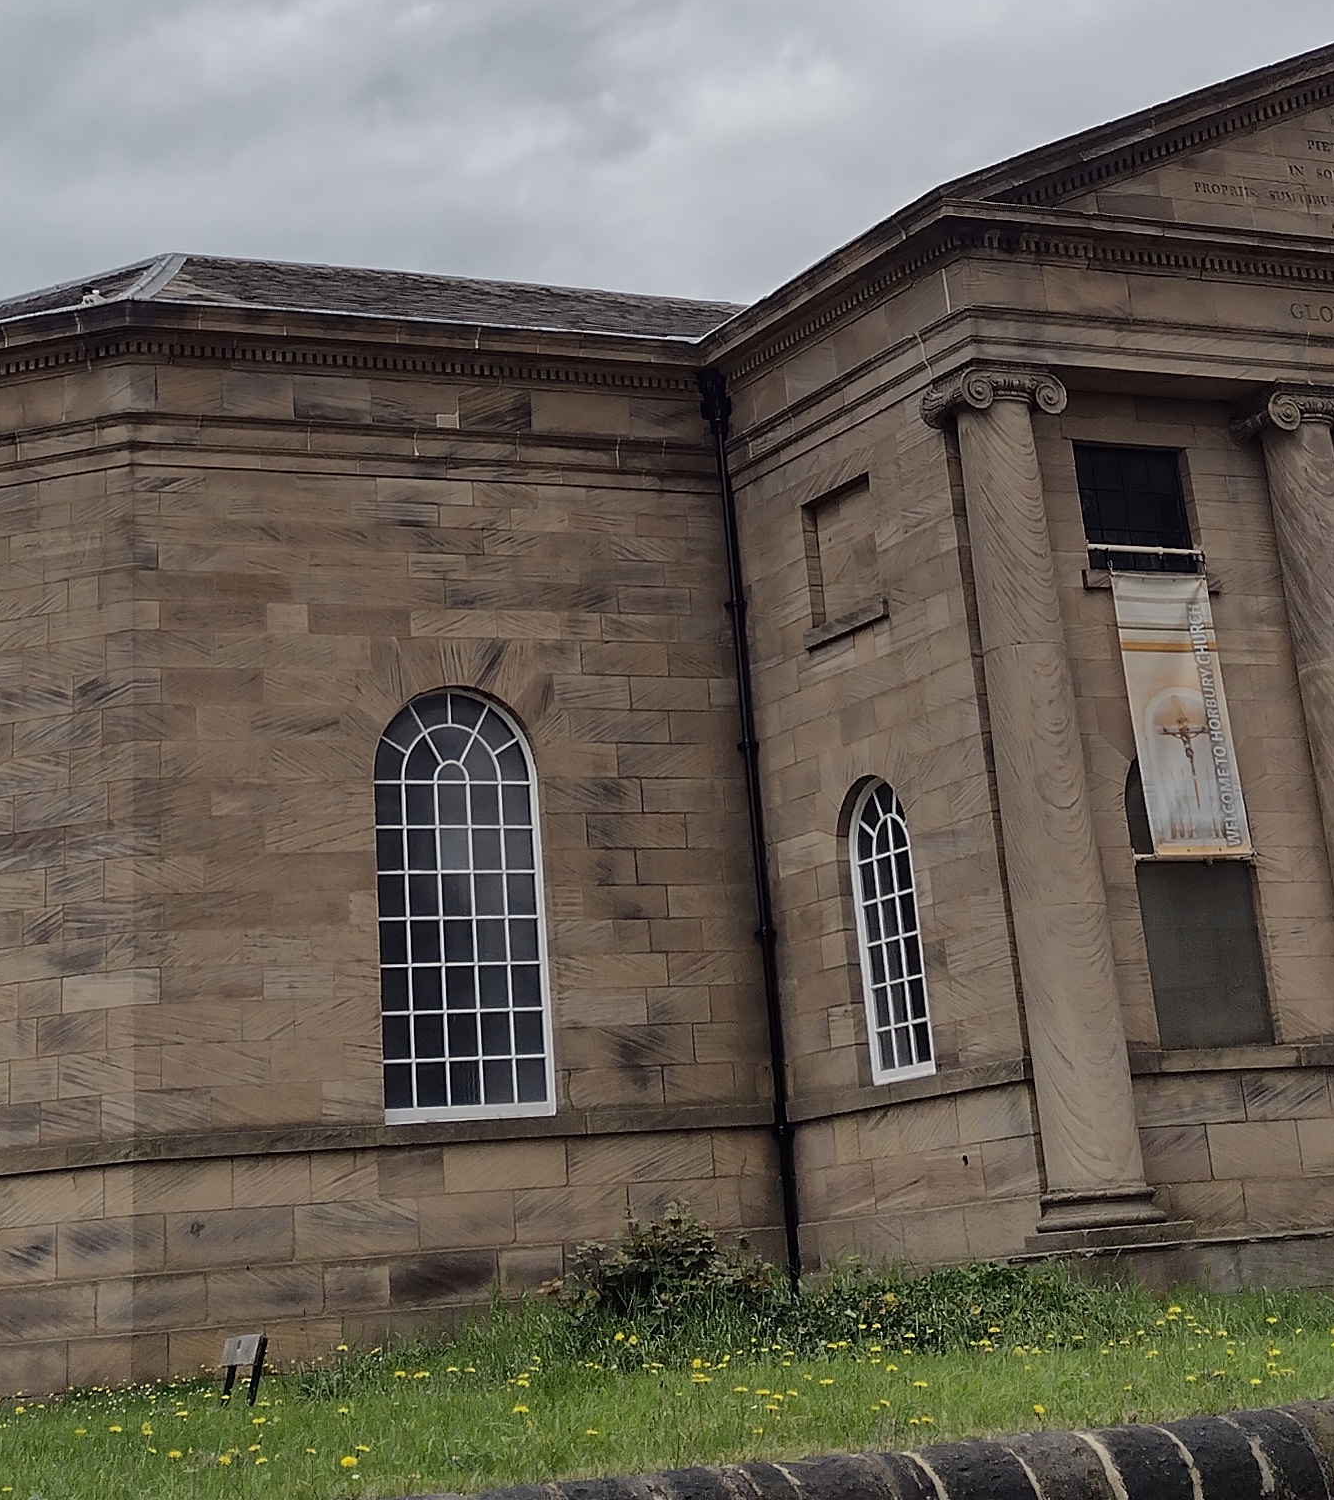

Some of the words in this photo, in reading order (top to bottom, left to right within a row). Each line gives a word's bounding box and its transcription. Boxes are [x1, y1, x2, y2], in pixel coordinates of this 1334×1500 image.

[1288, 165, 1305, 176] IN
[1188, 604, 1211, 665] CHURCH
[1199, 668, 1225, 742] HORBURY
[1213, 746, 1228, 766] TO
[1217, 768, 1242, 846] WELCOME
